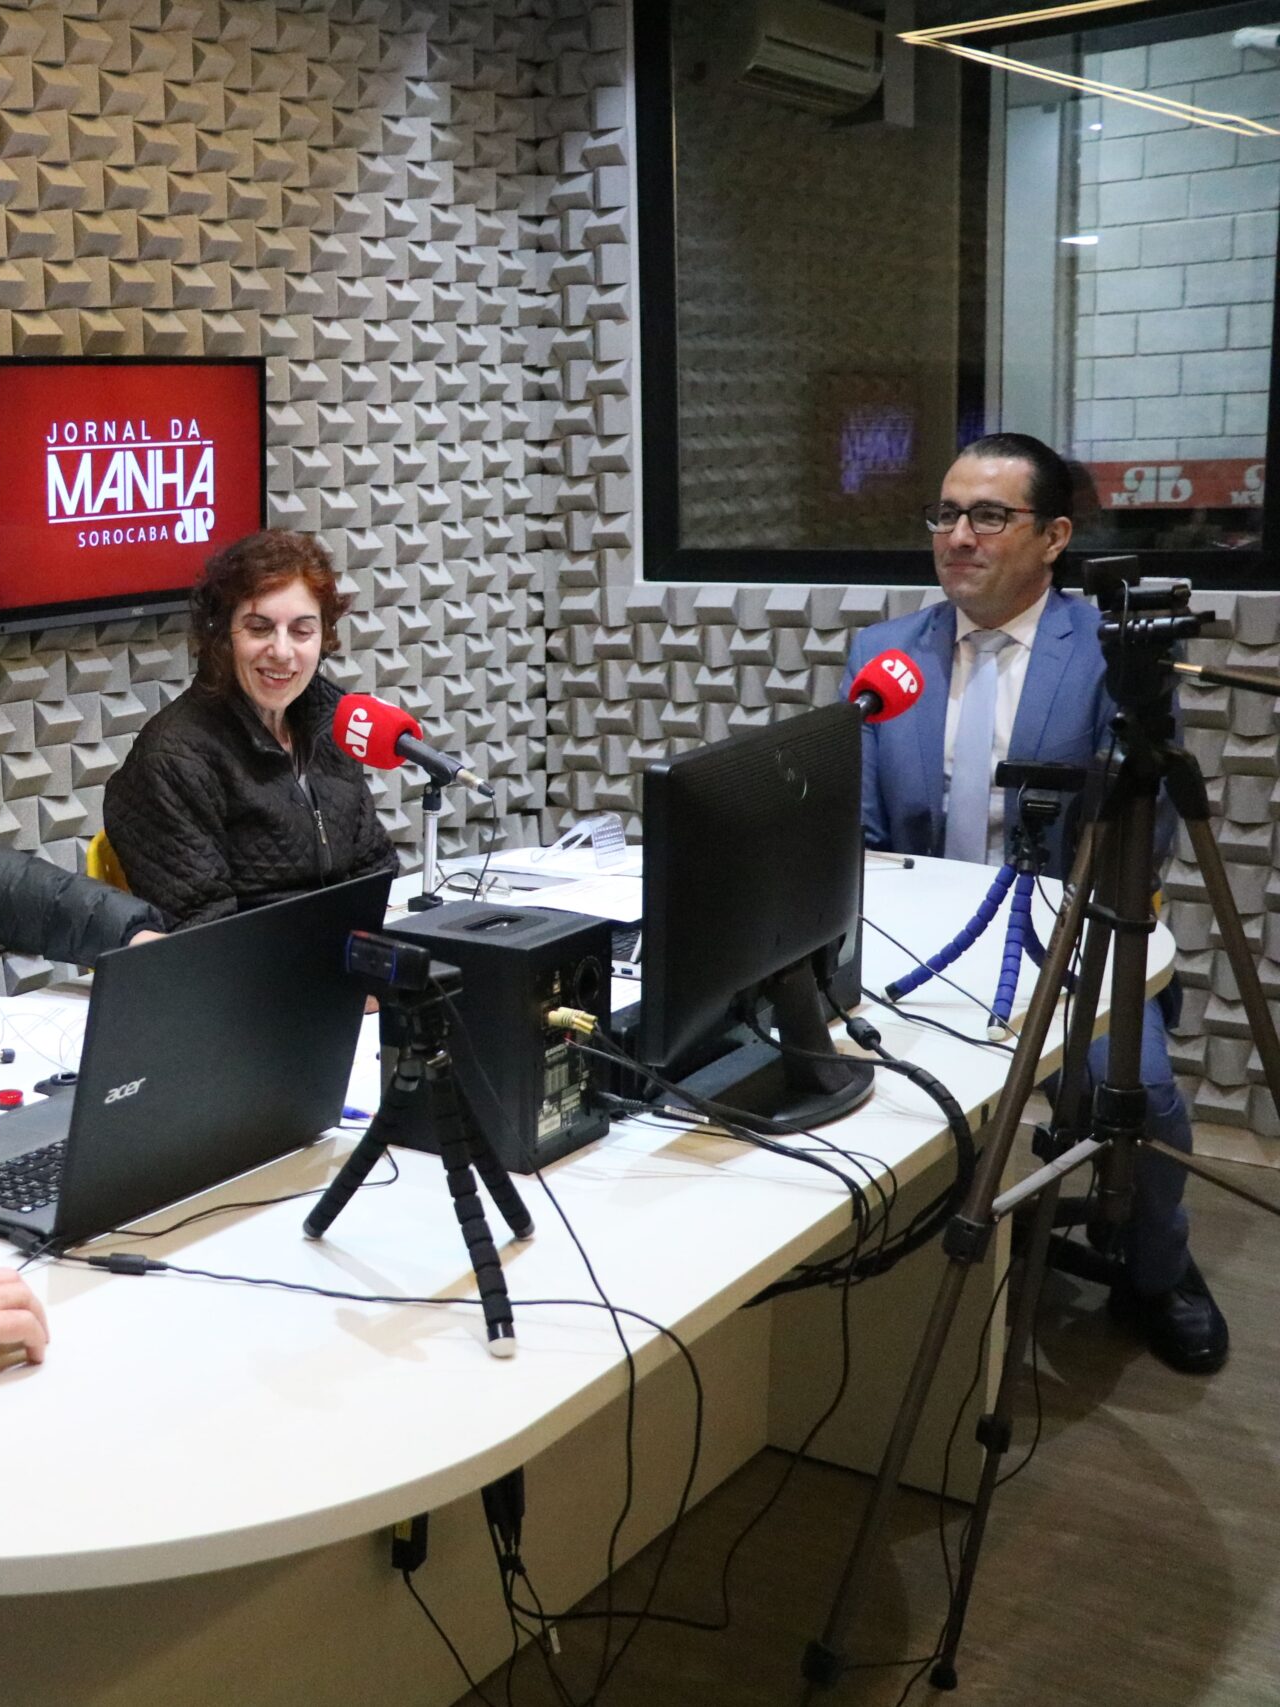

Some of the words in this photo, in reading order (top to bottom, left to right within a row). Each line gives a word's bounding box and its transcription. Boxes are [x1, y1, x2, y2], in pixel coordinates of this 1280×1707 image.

[47, 420, 151, 444] JORNAL
[171, 418, 200, 440] DA
[78, 525, 169, 548] SOROCABA
[174, 507, 216, 544] JP
[104, 1077, 147, 1104] acer
